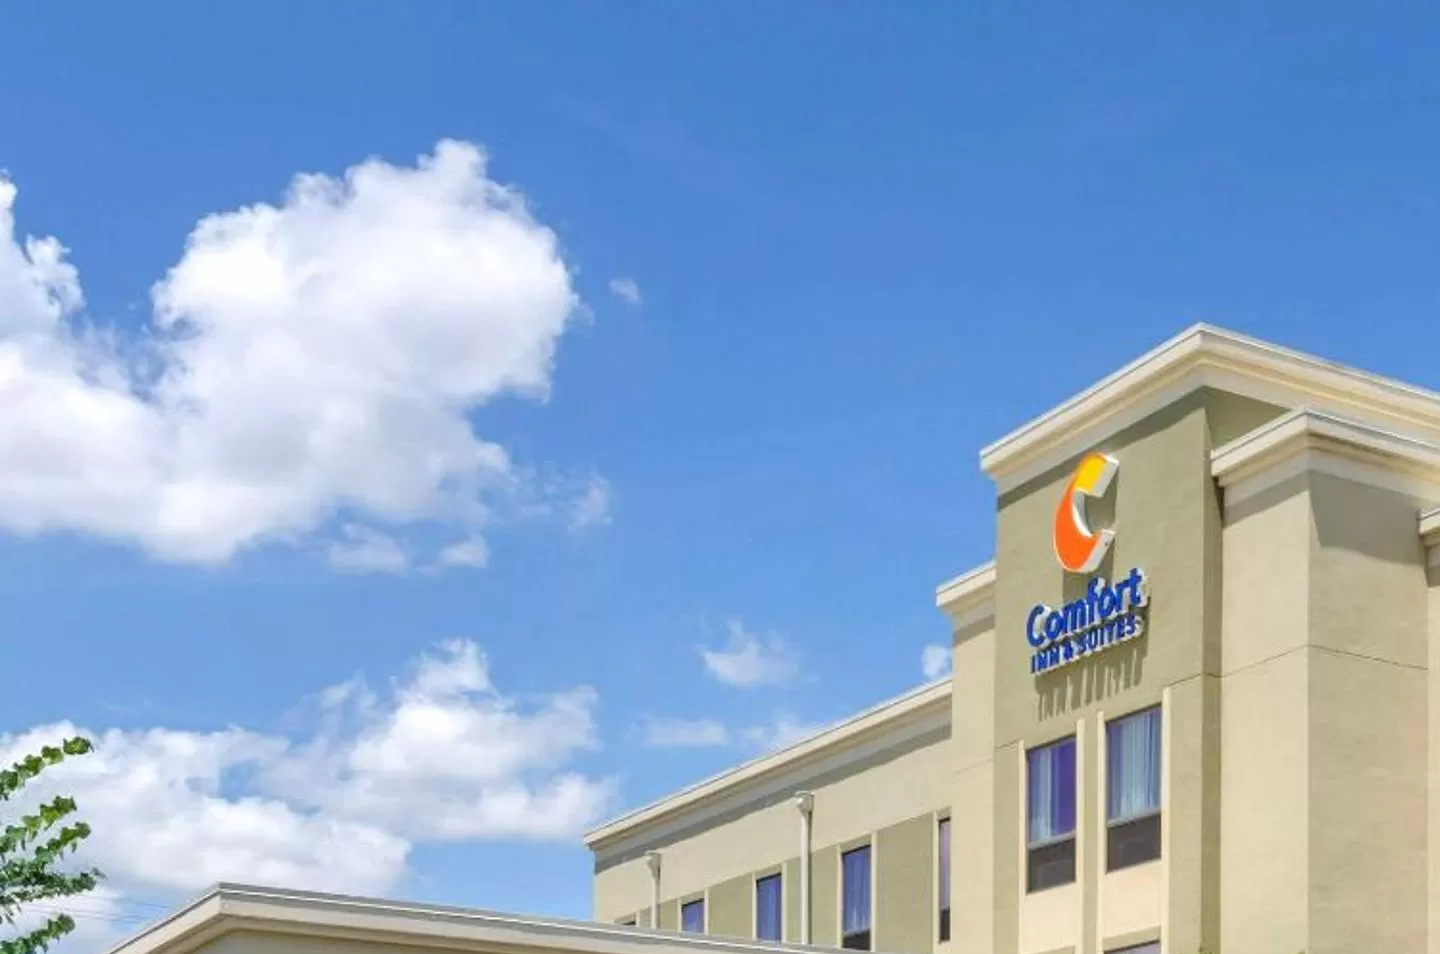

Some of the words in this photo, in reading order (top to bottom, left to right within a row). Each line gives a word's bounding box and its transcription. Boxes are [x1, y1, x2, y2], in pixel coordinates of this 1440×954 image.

[1027, 567, 1145, 647] Comfort
[1031, 644, 1061, 674] INN
[1077, 613, 1140, 654] SUITES
